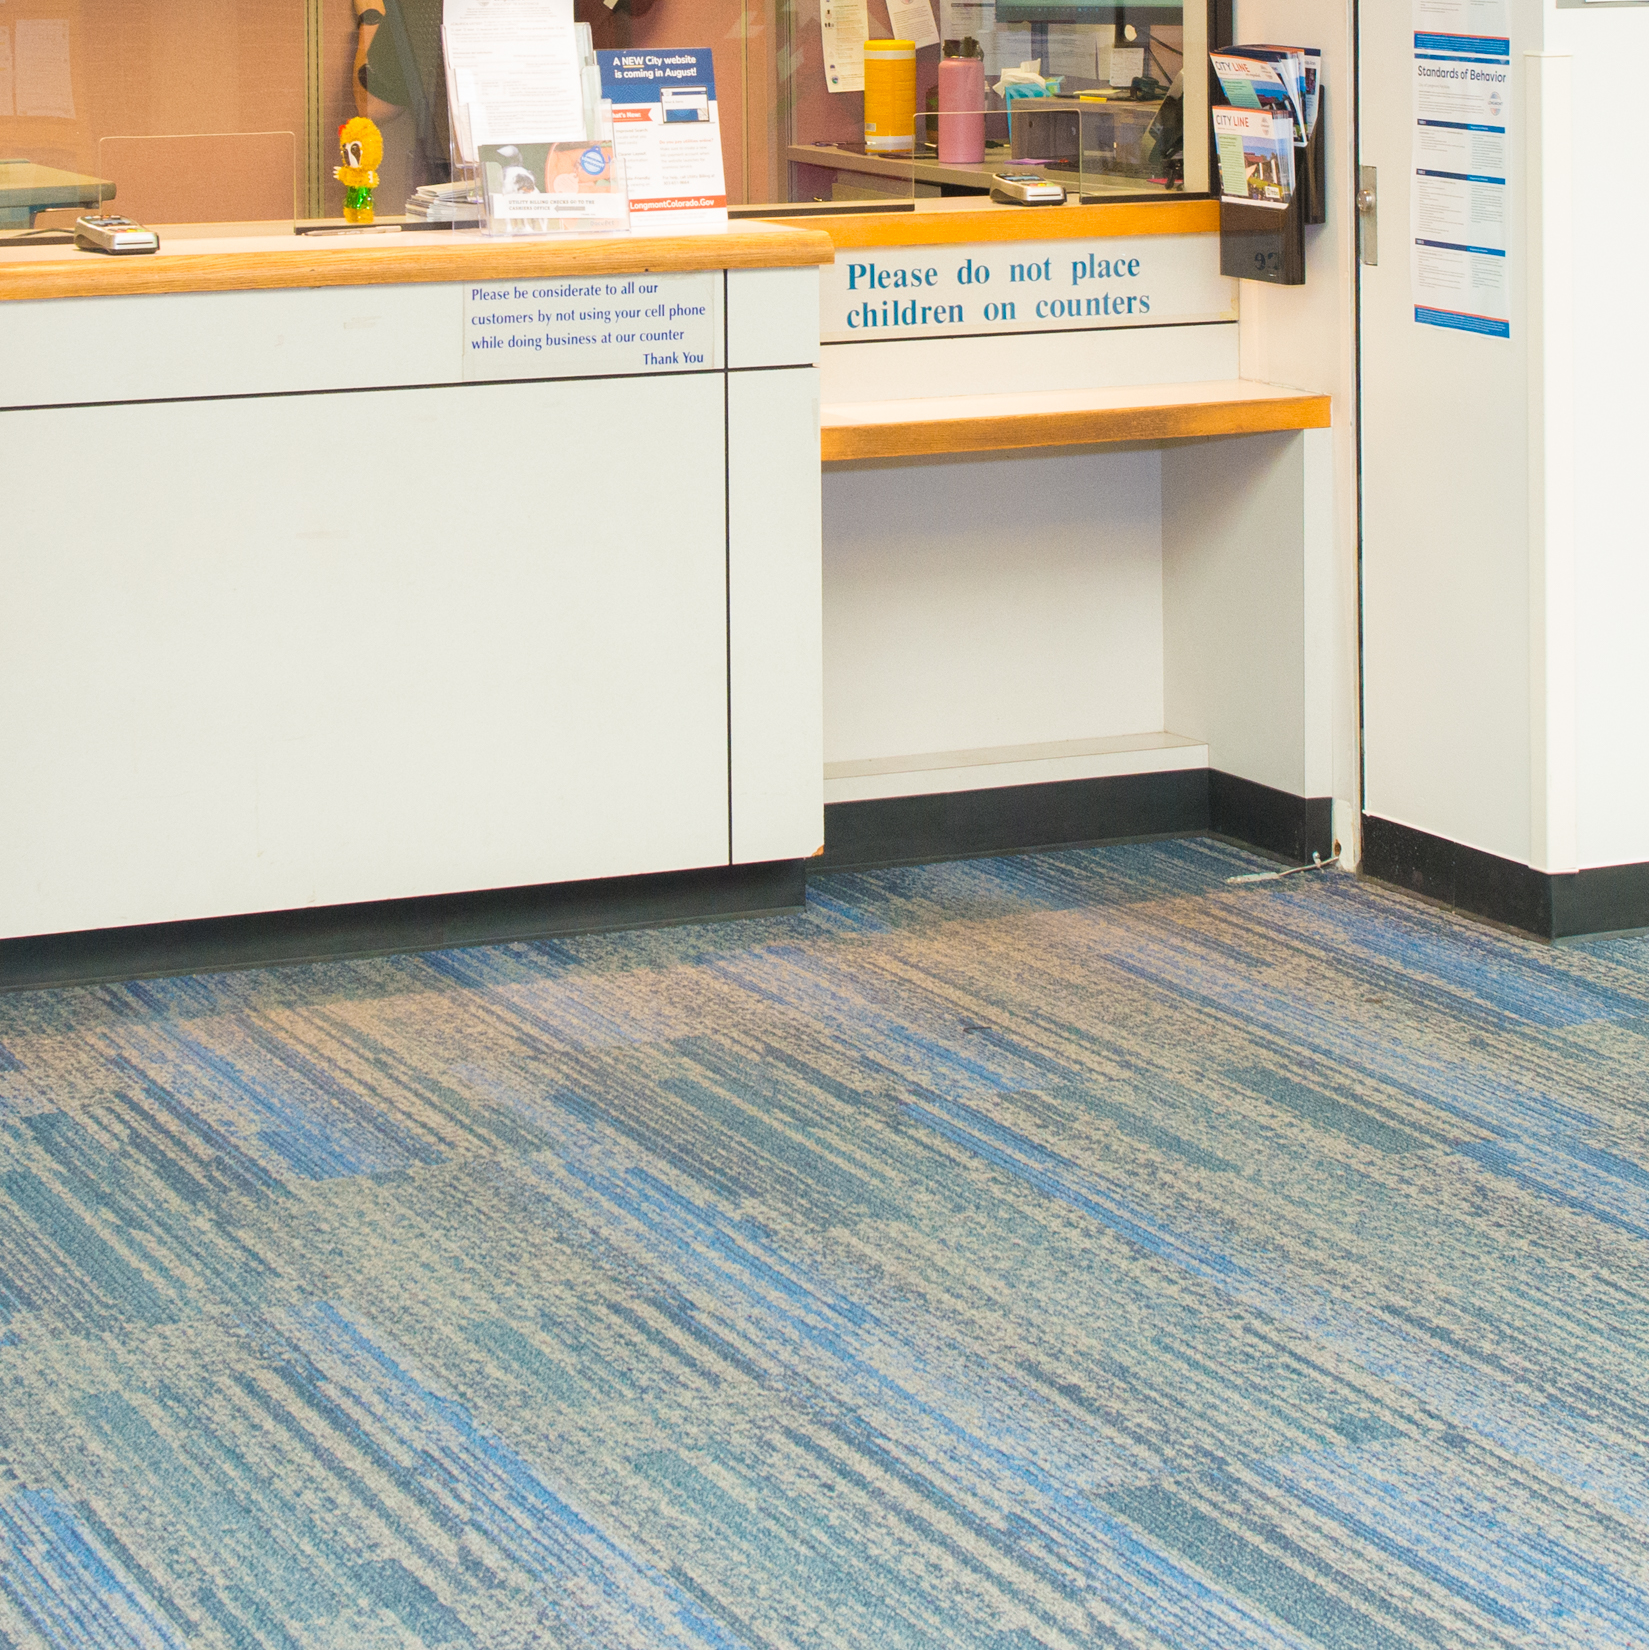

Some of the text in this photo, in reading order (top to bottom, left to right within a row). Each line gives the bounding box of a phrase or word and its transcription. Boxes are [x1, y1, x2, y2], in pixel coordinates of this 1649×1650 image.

[622, 57, 643, 65] NEW
[646, 56, 662, 66] City
[664, 56, 696, 64] website
[615, 68, 697, 79] is coming in August!
[1418, 66, 1506, 83] Standards of Behavior
[1216, 115, 1249, 127] CITY LINE
[630, 198, 714, 210] LongmontColorado.Gov
[846, 253, 1140, 290] Please do not place
[472, 282, 658, 301] Please be considerate to all our
[472, 305, 705, 326] customers by not using your cell phone
[846, 292, 1150, 328] children on counters
[472, 329, 684, 351] while doing business at our counter
[643, 352, 704, 365] Thank You
